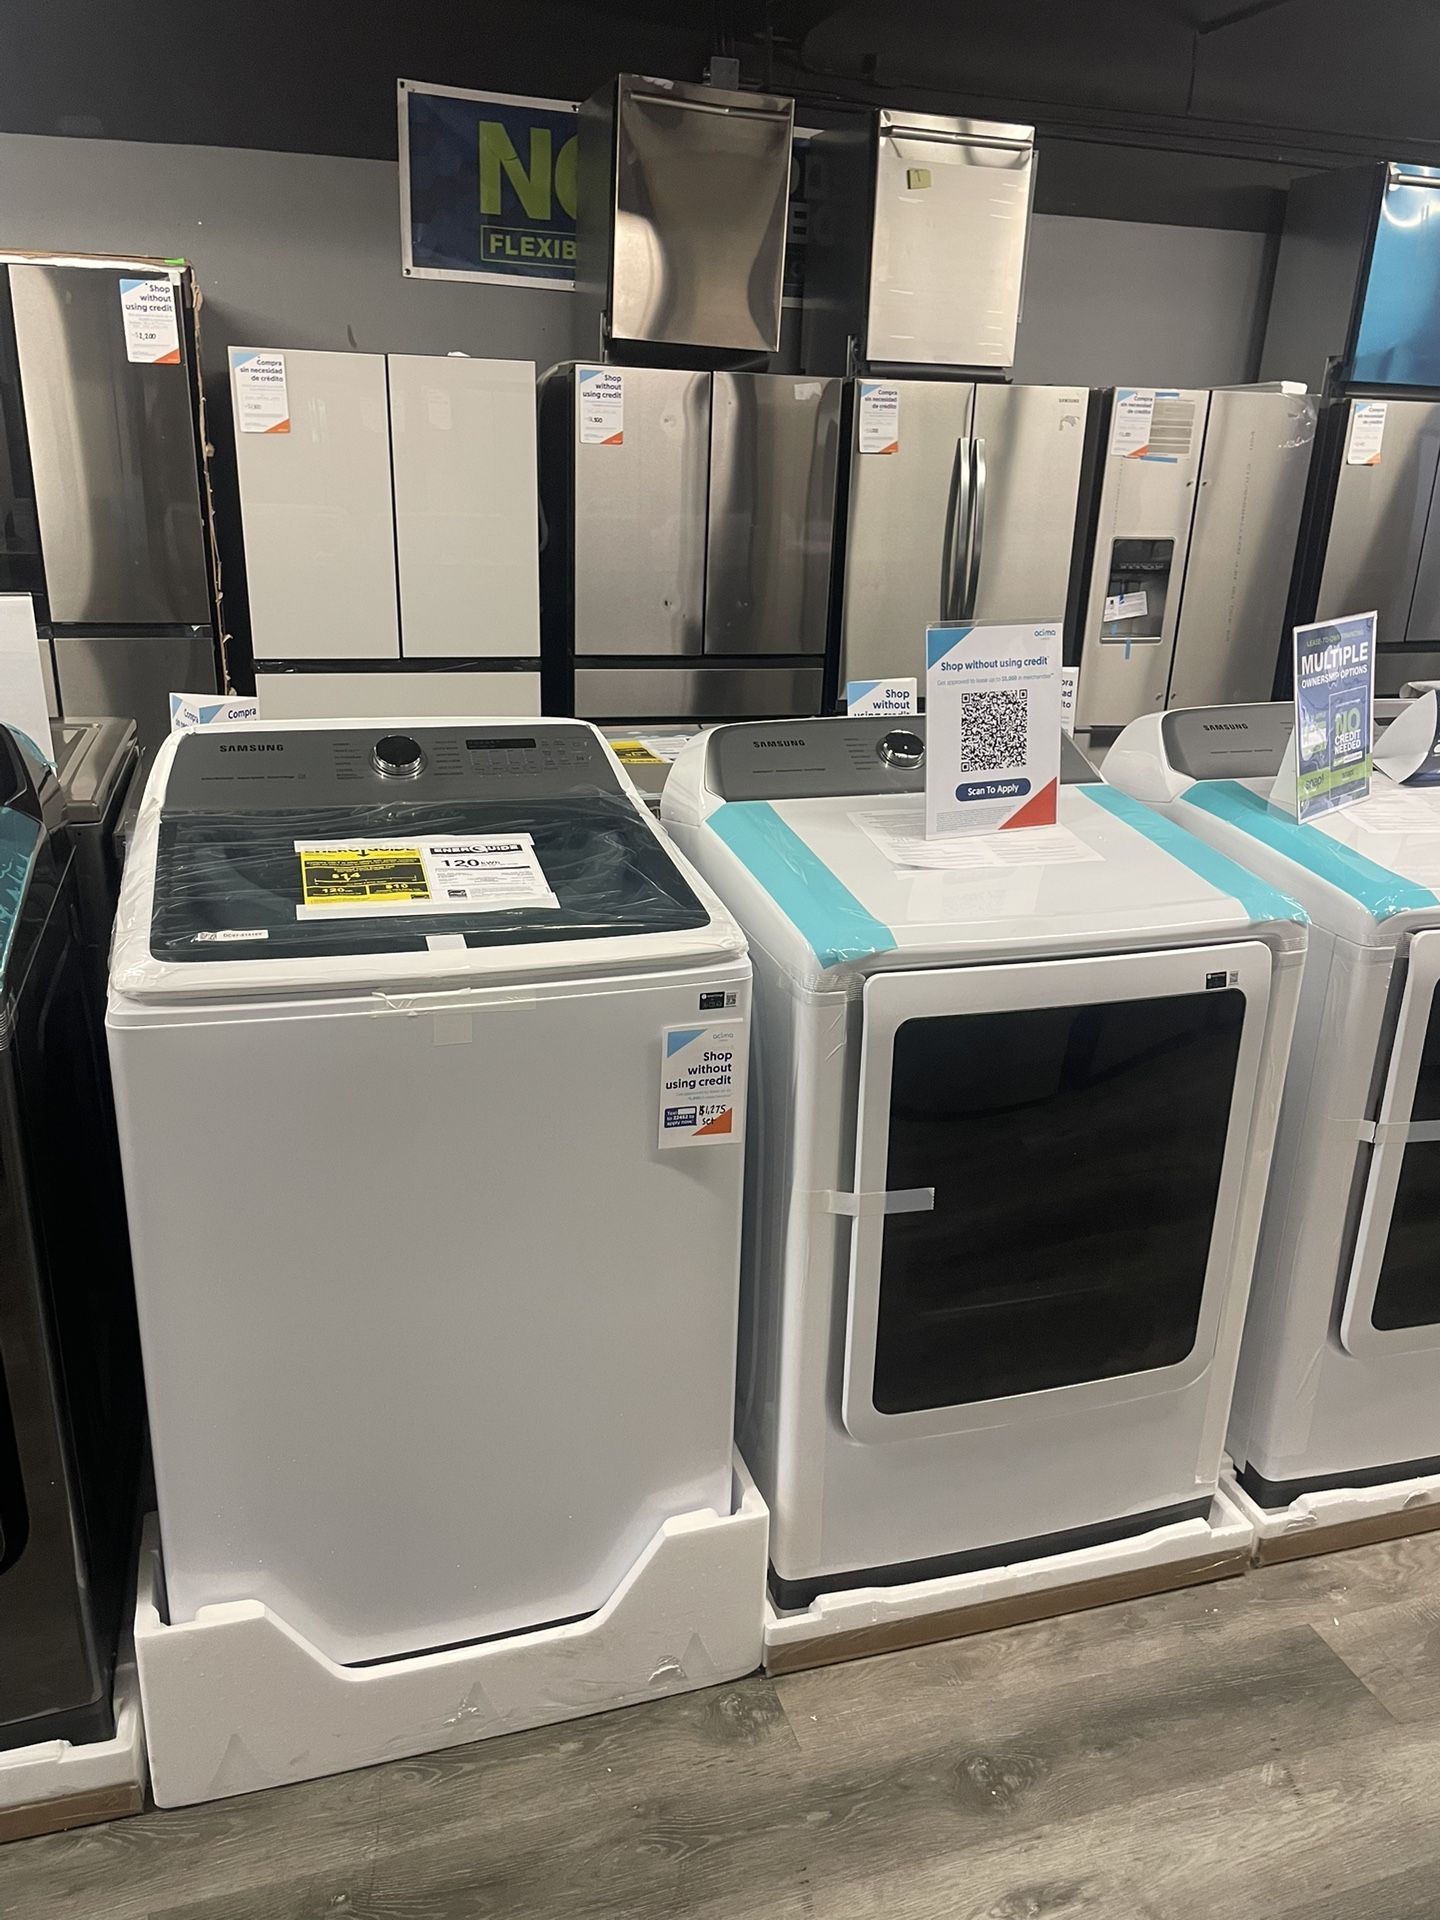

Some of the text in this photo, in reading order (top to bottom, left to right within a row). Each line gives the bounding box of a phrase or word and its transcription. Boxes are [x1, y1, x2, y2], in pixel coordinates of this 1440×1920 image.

[480, 121, 577, 220] N
[149, 284, 170, 294] Shop
[140, 294, 172, 302] without
[125, 303, 173, 312] using credit
[604, 374, 622, 382] Shop
[583, 391, 601, 399] using
[1034, 628, 1056, 637] acima
[941, 656, 1048, 672] Shop without using credit
[1301, 641, 1369, 676] MULTIPLE
[1301, 664, 1368, 688] OWNERSHIP OPTIONS
[886, 689, 910, 700] Shop
[873, 700, 910, 709] without
[228, 707, 256, 719] Compra
[1202, 723, 1249, 731] SAMSUNG
[1334, 729, 1361, 745] CREDIT
[219, 744, 284, 752] SAMSUNG
[753, 740, 806, 749] SAMSUNG
[1334, 740, 1361, 755] NEEDED
[967, 784, 1019, 796] Scan To Apply
[441, 859, 480, 867] 120
[713, 1032, 734, 1040] acima
[703, 1051, 733, 1062] Shop
[688, 1063, 732, 1075] without
[666, 1075, 731, 1090] using credit
[699, 1104, 726, 1116] $1,275
